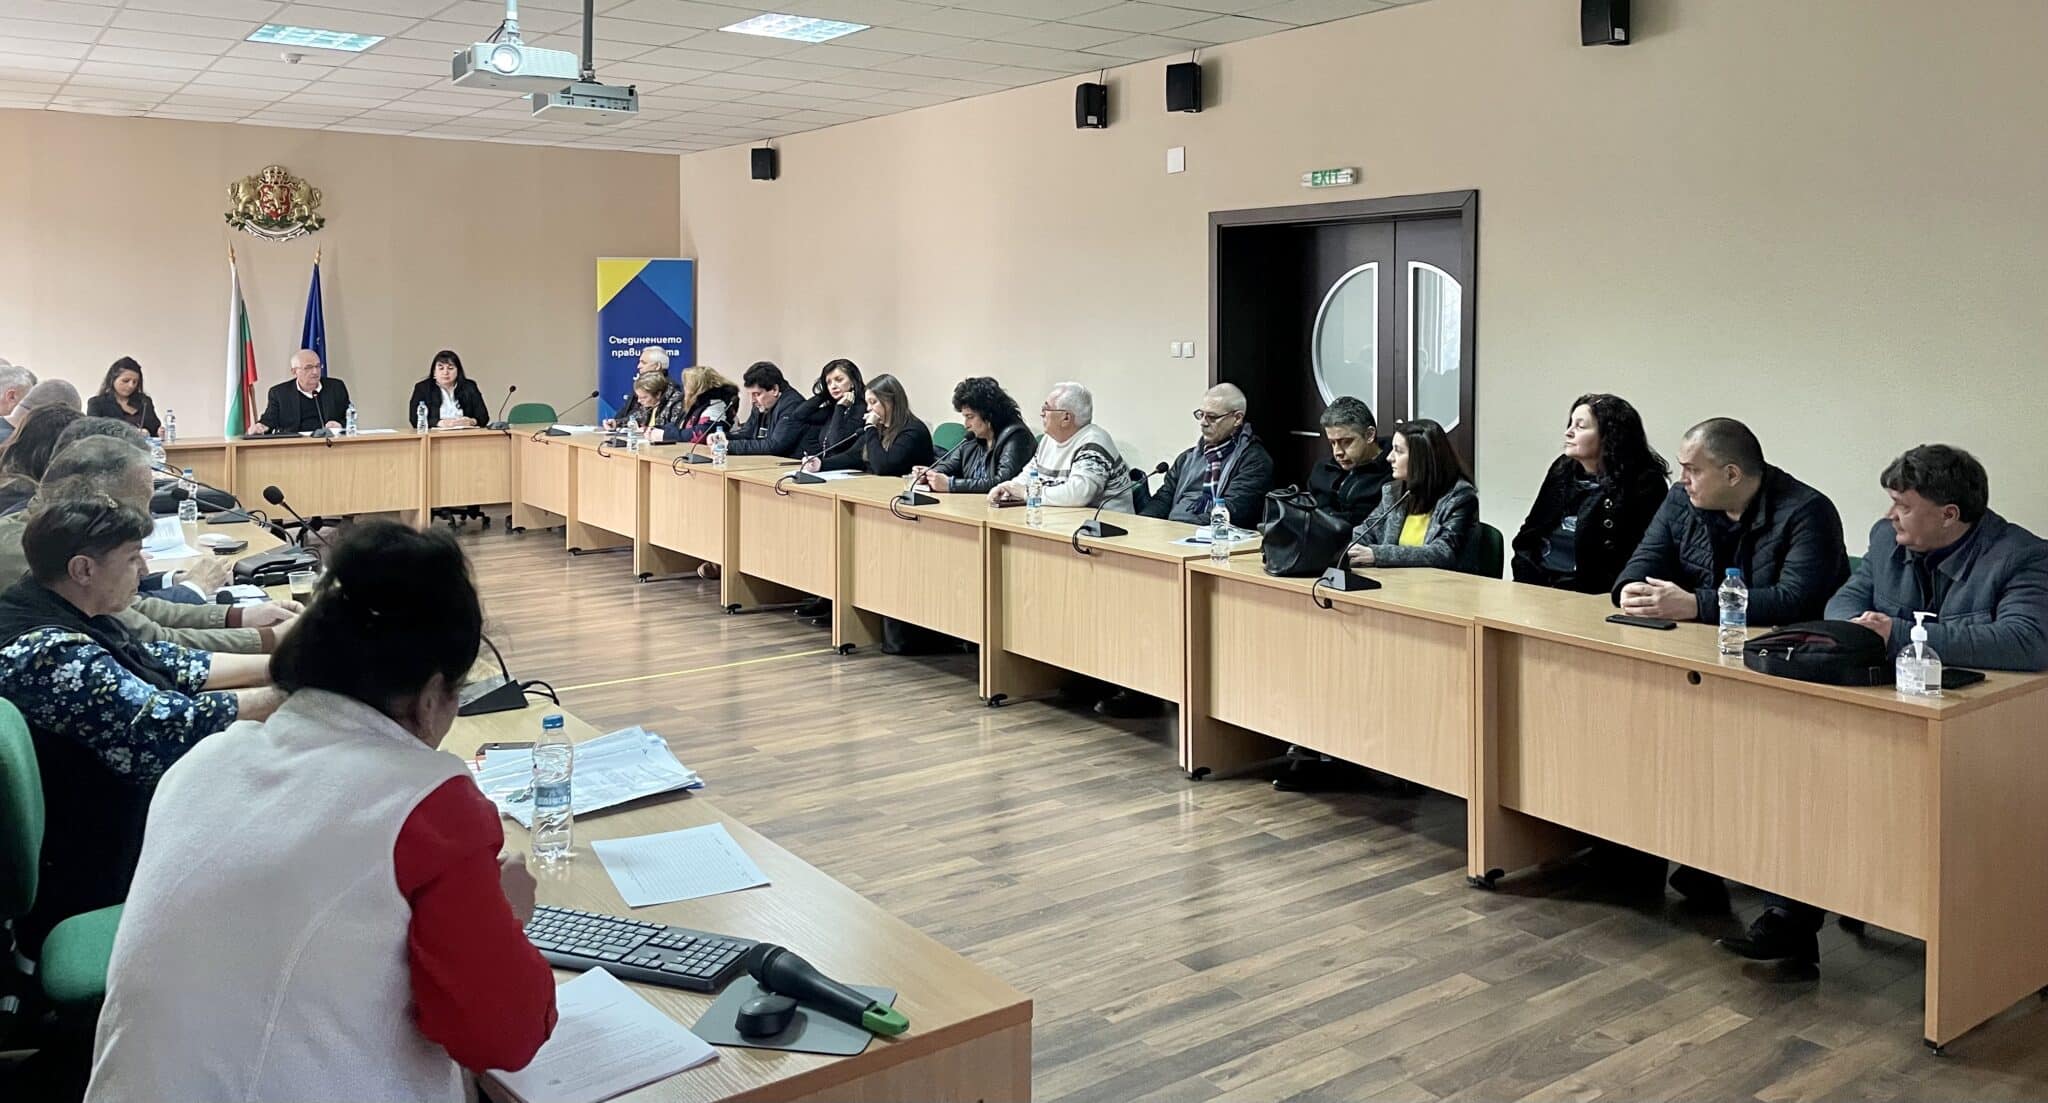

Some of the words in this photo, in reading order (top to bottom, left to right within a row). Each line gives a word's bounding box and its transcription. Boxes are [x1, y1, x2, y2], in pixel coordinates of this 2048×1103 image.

[1312, 169, 1341, 186] EXIT
[609, 336, 682, 345] Съединението
[612, 348, 641, 358] прави
